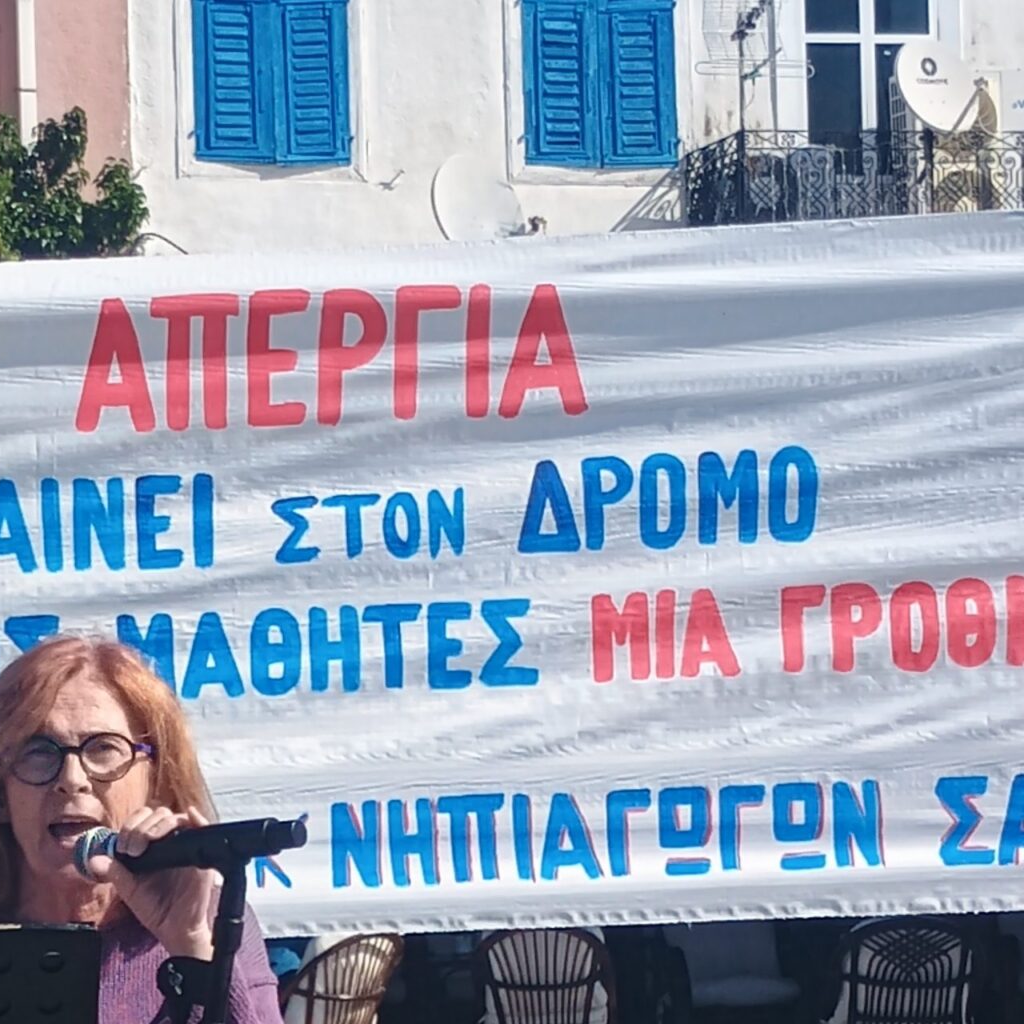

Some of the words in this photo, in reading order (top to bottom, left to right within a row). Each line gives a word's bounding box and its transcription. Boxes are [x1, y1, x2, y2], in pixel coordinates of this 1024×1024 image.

[75, 283, 588, 432] ΑΠΕΡΓΙΑ
[271, 486, 466, 565] ΣΤΟΝ
[517, 445, 821, 554] ΔΡΟΜΟ
[590, 588, 742, 684] ΜΙΑ
[329, 778, 885, 890] ΝΗΠΙΑΓΩΓΩΝ
